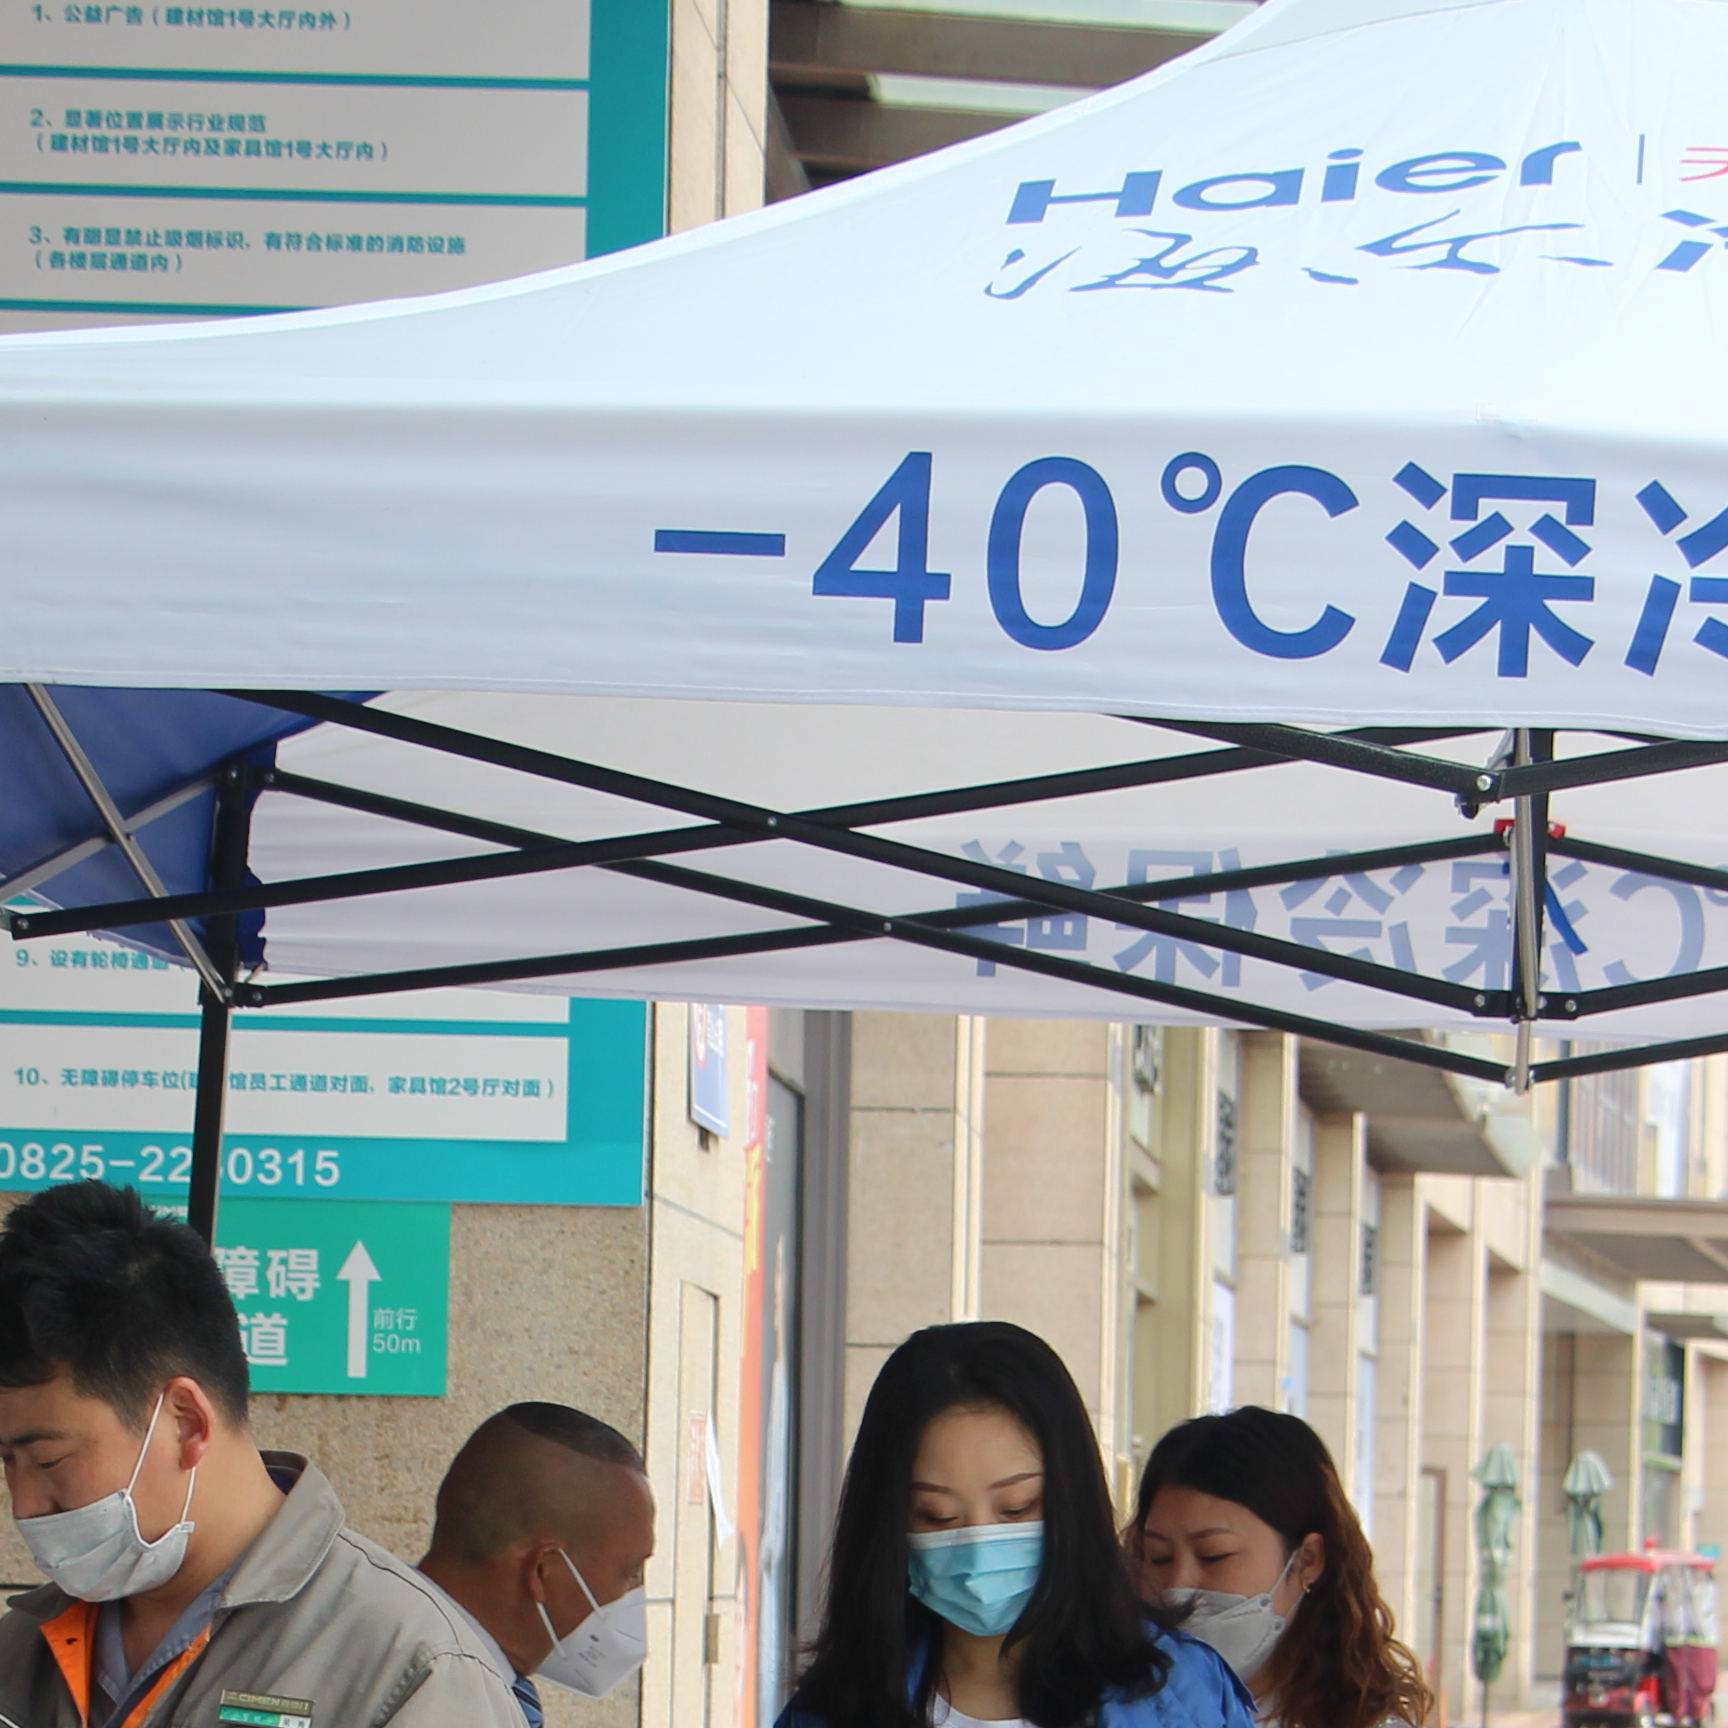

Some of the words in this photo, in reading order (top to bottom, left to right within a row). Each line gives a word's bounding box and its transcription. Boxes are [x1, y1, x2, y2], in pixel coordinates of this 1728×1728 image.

[1006, 140, 1582, 224] Haier
[373, 1307, 417, 1331] 前行
[372, 1332, 422, 1354] 50m
